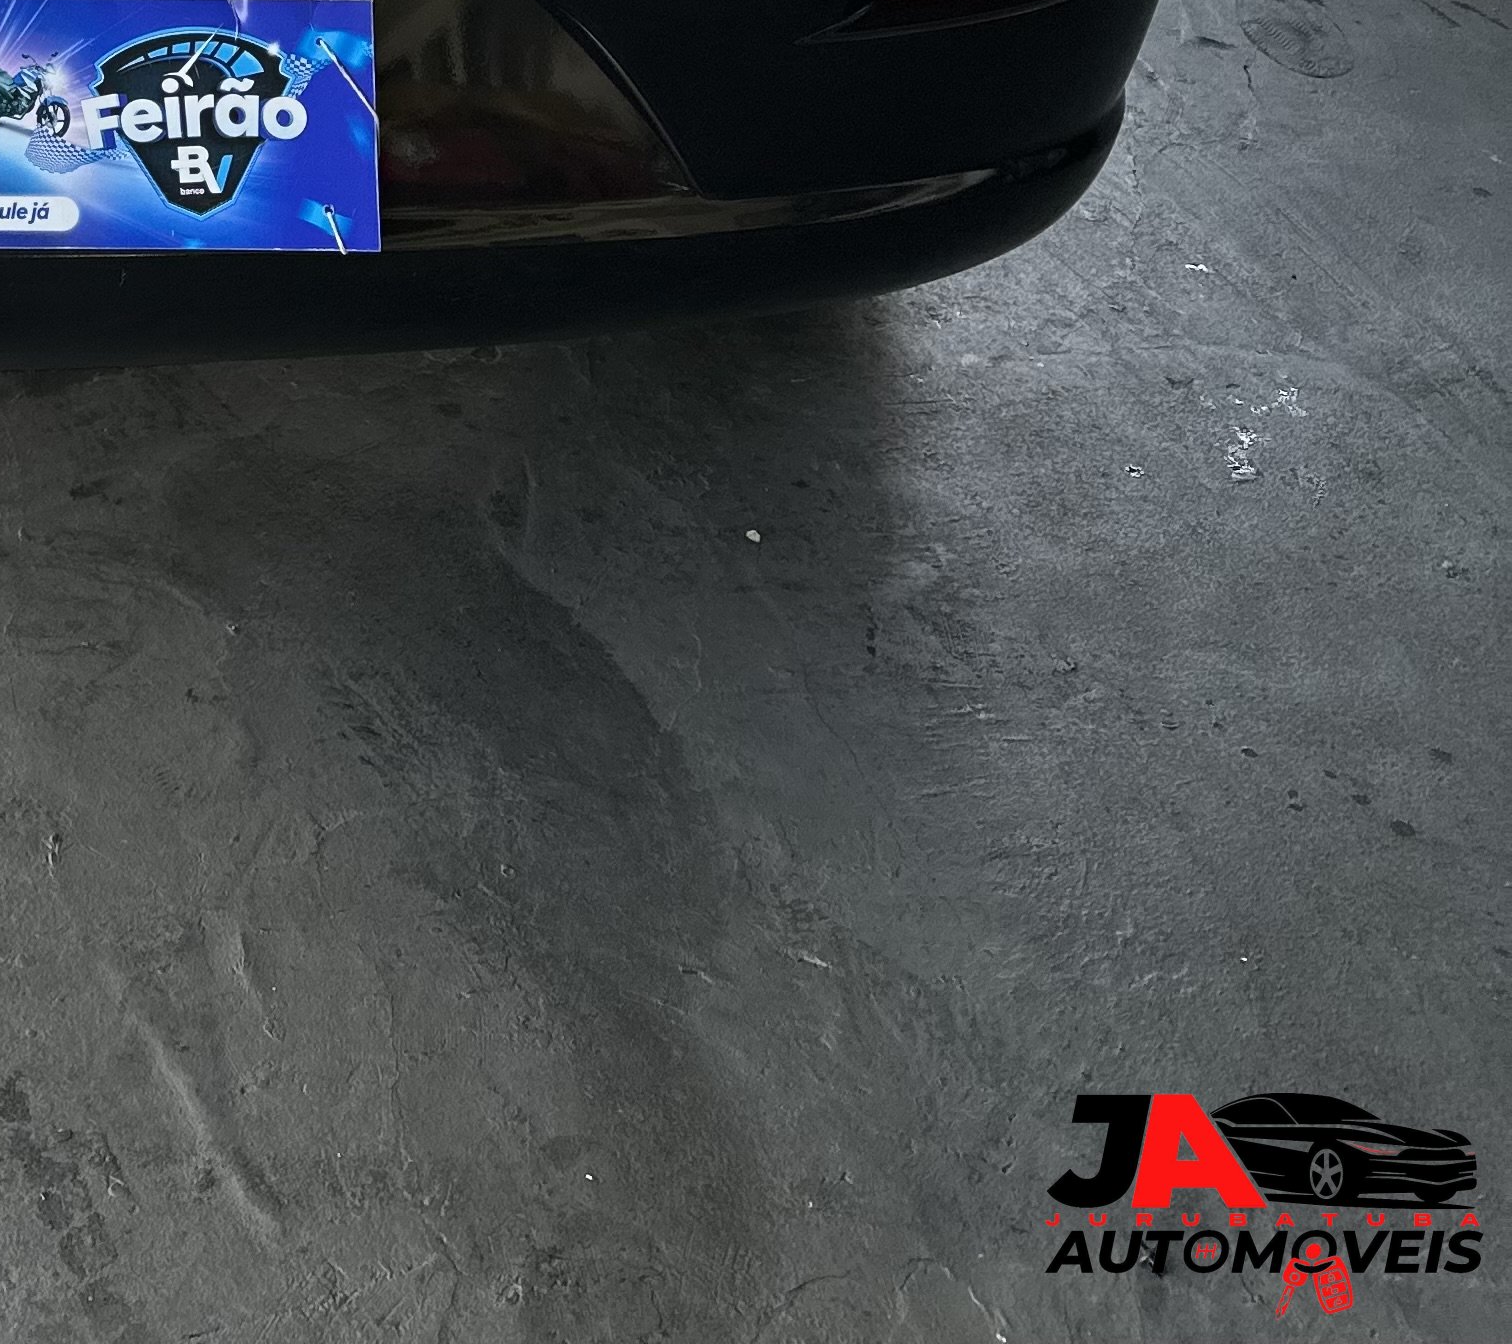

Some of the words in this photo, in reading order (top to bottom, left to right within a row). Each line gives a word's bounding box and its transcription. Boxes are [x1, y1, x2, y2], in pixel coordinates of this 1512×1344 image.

[80, 77, 308, 150] Feirão
[170, 145, 234, 194] BV
[179, 187, 205, 196] banco
[28, 201, 50, 225] já
